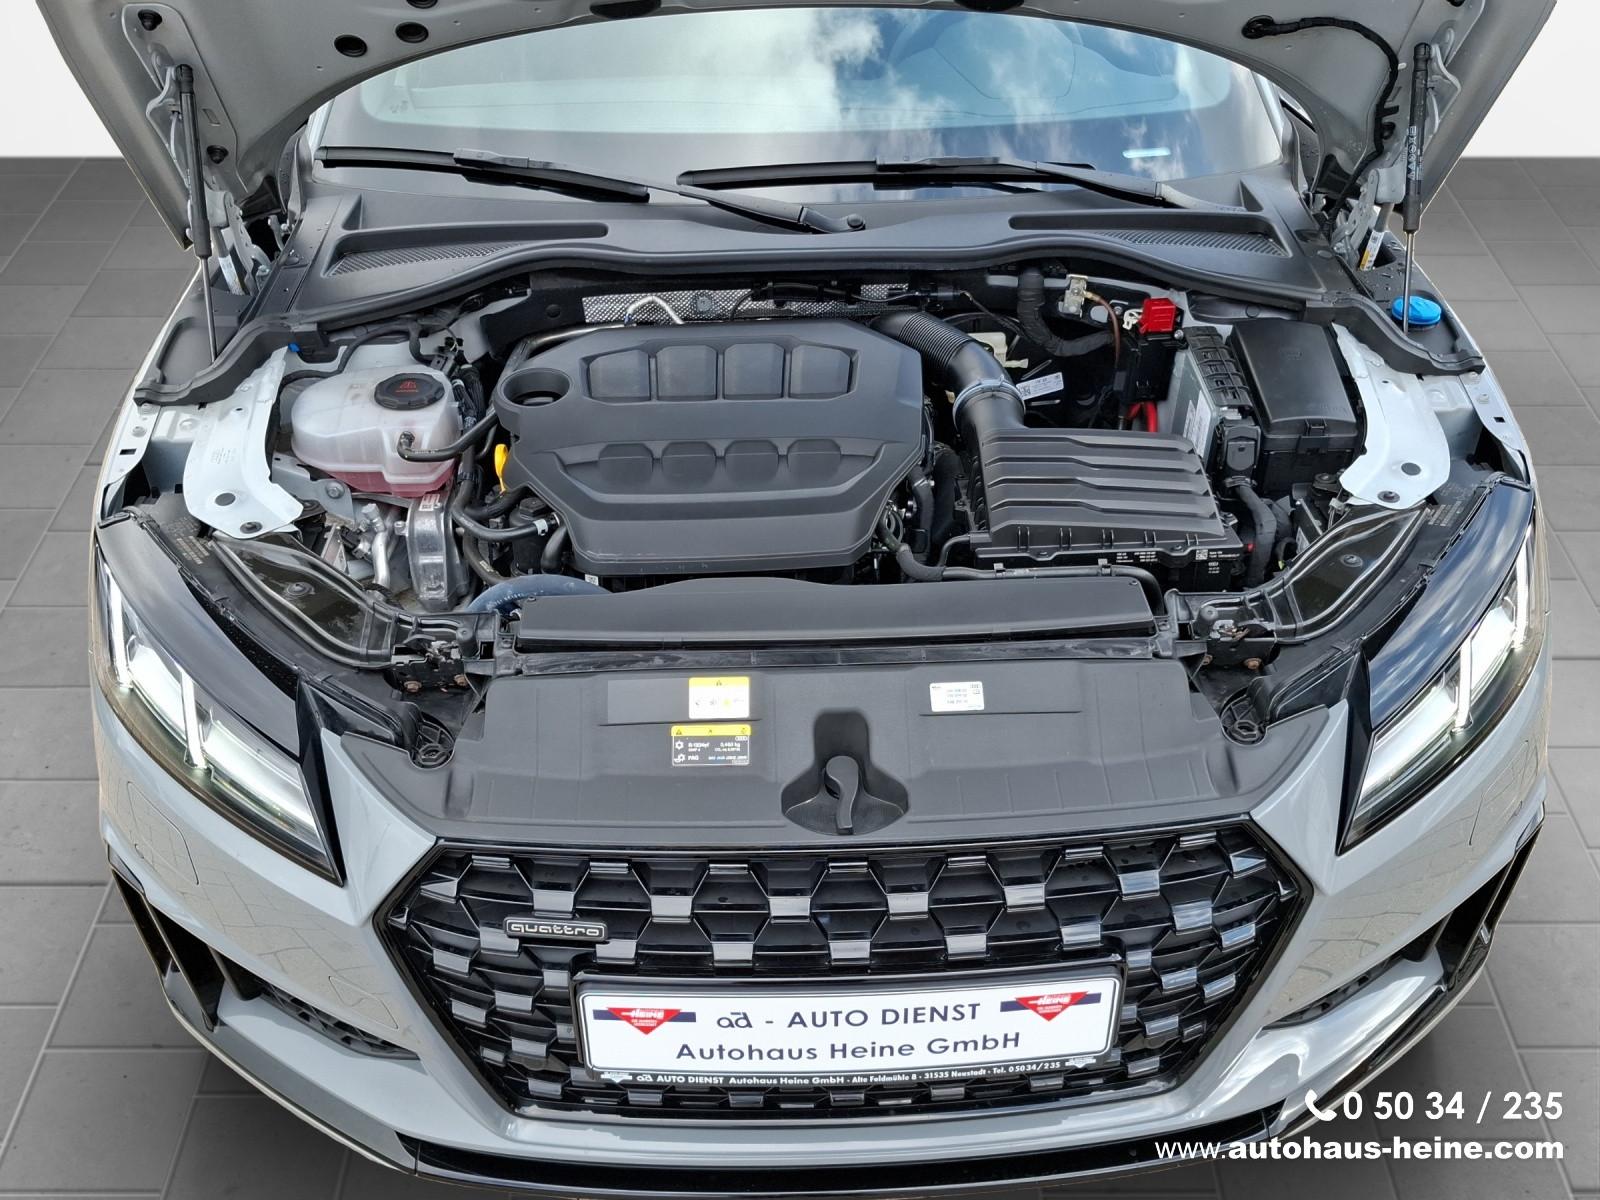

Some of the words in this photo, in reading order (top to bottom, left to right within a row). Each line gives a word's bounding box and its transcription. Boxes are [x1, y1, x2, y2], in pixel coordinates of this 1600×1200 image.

[511, 923, 599, 936] quattro
[787, 1009, 868, 1028] AUTO
[881, 1003, 980, 1025] DIENST
[676, 1043, 817, 1060] Autohaus
[830, 1043, 915, 1059] Heine
[927, 1032, 1019, 1054] GmbH
[656, 1075, 685, 1083] AUTO
[688, 1076, 723, 1084] DIENST
[729, 1076, 777, 1085] Autohaus
[780, 1076, 809, 1085] Heine
[812, 1076, 844, 1084] GmbH
[951, 1069, 986, 1077] Neustadt
